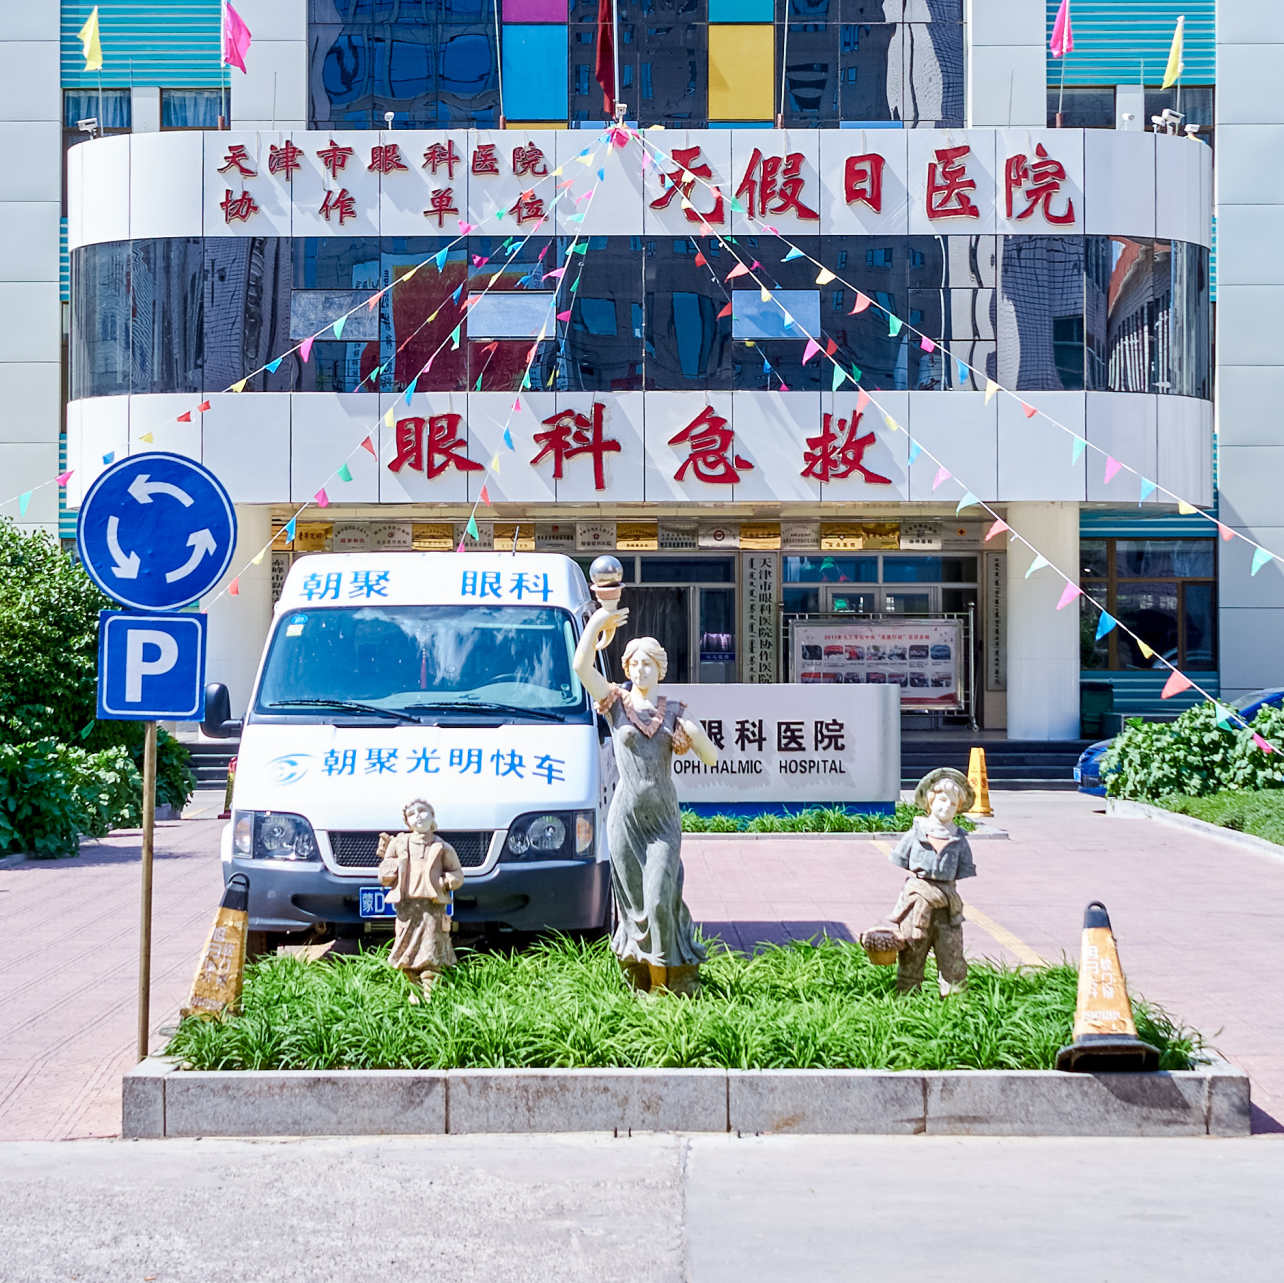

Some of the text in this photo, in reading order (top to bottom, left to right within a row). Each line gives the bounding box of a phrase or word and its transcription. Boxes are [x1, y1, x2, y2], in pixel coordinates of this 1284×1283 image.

[217, 139, 551, 182] 天津市眼科医院
[649, 143, 1076, 225] 无假日医院
[220, 188, 549, 228] 协作单位
[388, 402, 893, 491] 眼科急救
[300, 570, 554, 603] 朝聚 眼科
[758, 557, 773, 683] 天津市眼科医院协作医院
[126, 629, 179, 703] P
[322, 747, 567, 786] 朝聚光明快车
[779, 759, 846, 774] HOSPITAL
